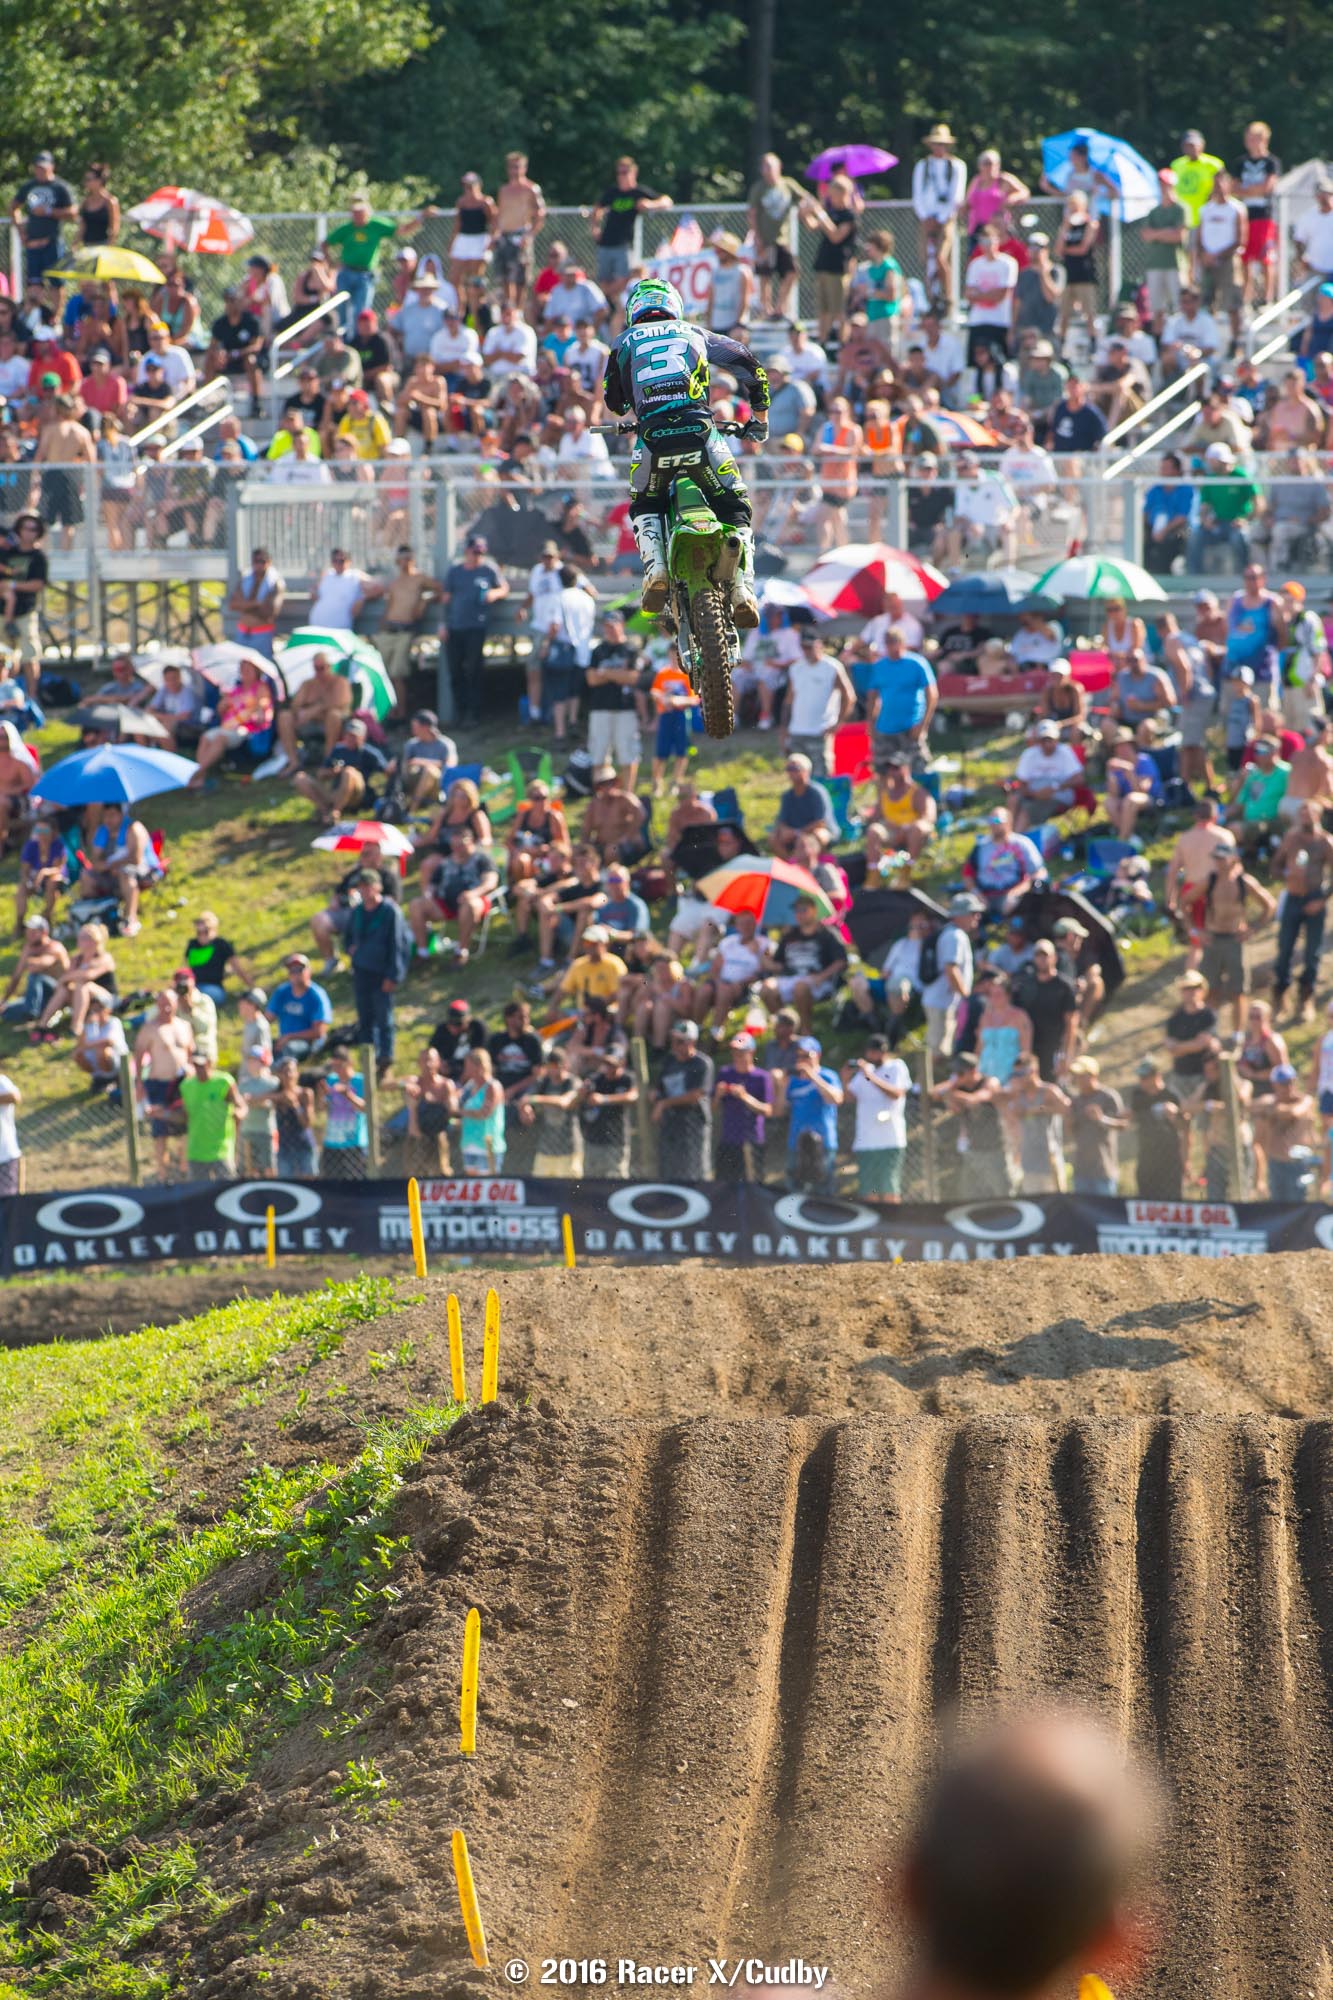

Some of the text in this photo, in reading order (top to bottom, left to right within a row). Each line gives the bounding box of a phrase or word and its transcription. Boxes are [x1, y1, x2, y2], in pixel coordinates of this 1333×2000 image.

[636, 337, 690, 382] 3
[657, 450, 702, 469] ET3
[421, 1183, 518, 1203] LUCAS OIL
[1135, 1203, 1231, 1226] LUCAS OIL
[194, 1227, 351, 1251] OAKLEY
[380, 1216, 559, 1241] MTOCROSS
[13, 1233, 177, 1266] OAKLEY
[584, 1229, 738, 1254] OAKLEY
[752, 1233, 907, 1260] OAKLEY
